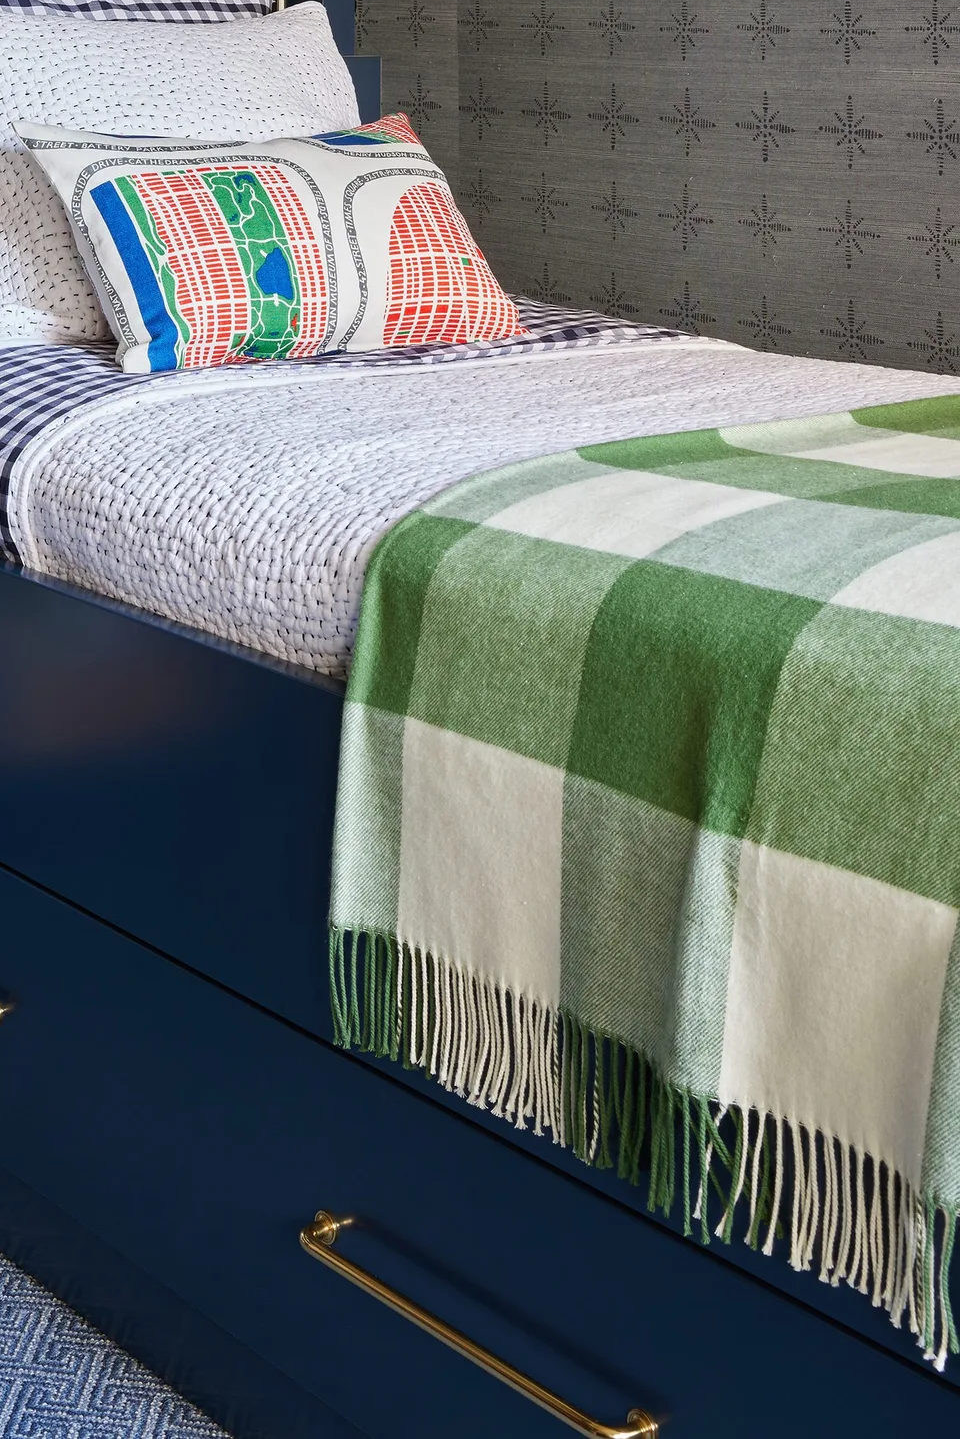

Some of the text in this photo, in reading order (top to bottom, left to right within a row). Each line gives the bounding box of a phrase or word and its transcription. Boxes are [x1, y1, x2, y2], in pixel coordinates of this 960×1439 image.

[33, 141, 125, 151] STREET BATTERY
[72, 154, 243, 228] RIVERSIDE DRIVE CATHEDRAL CENTRAL
[344, 202, 355, 229] TIMES
[321, 218, 337, 303] MUSEUM OF ART
